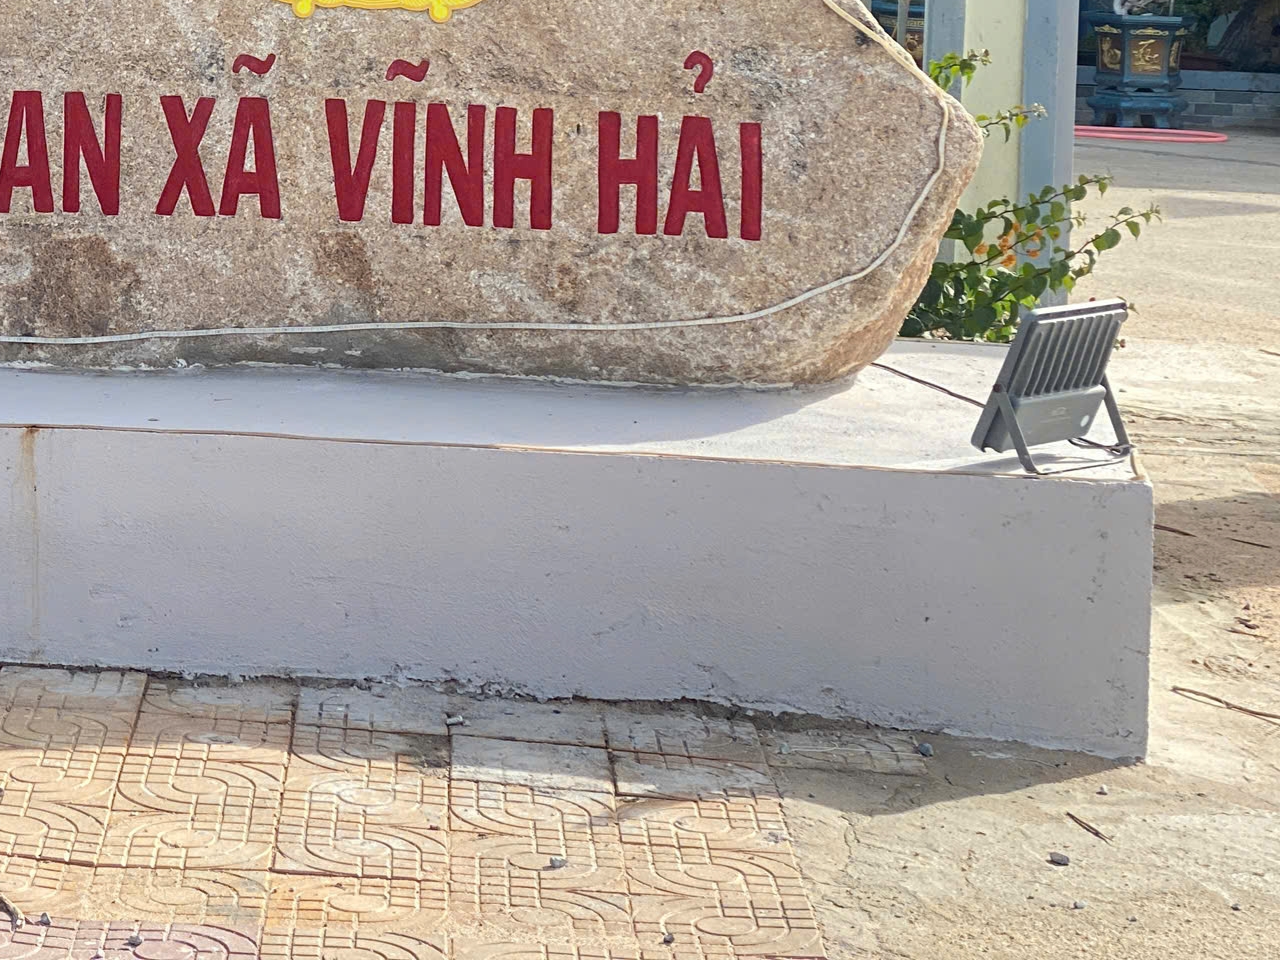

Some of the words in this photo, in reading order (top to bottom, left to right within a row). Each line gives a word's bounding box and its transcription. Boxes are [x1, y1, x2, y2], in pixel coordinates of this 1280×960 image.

[155, 54, 281, 218] XÃ
[325, 59, 554, 229] VĨNH
[597, 50, 762, 240] HẢI
